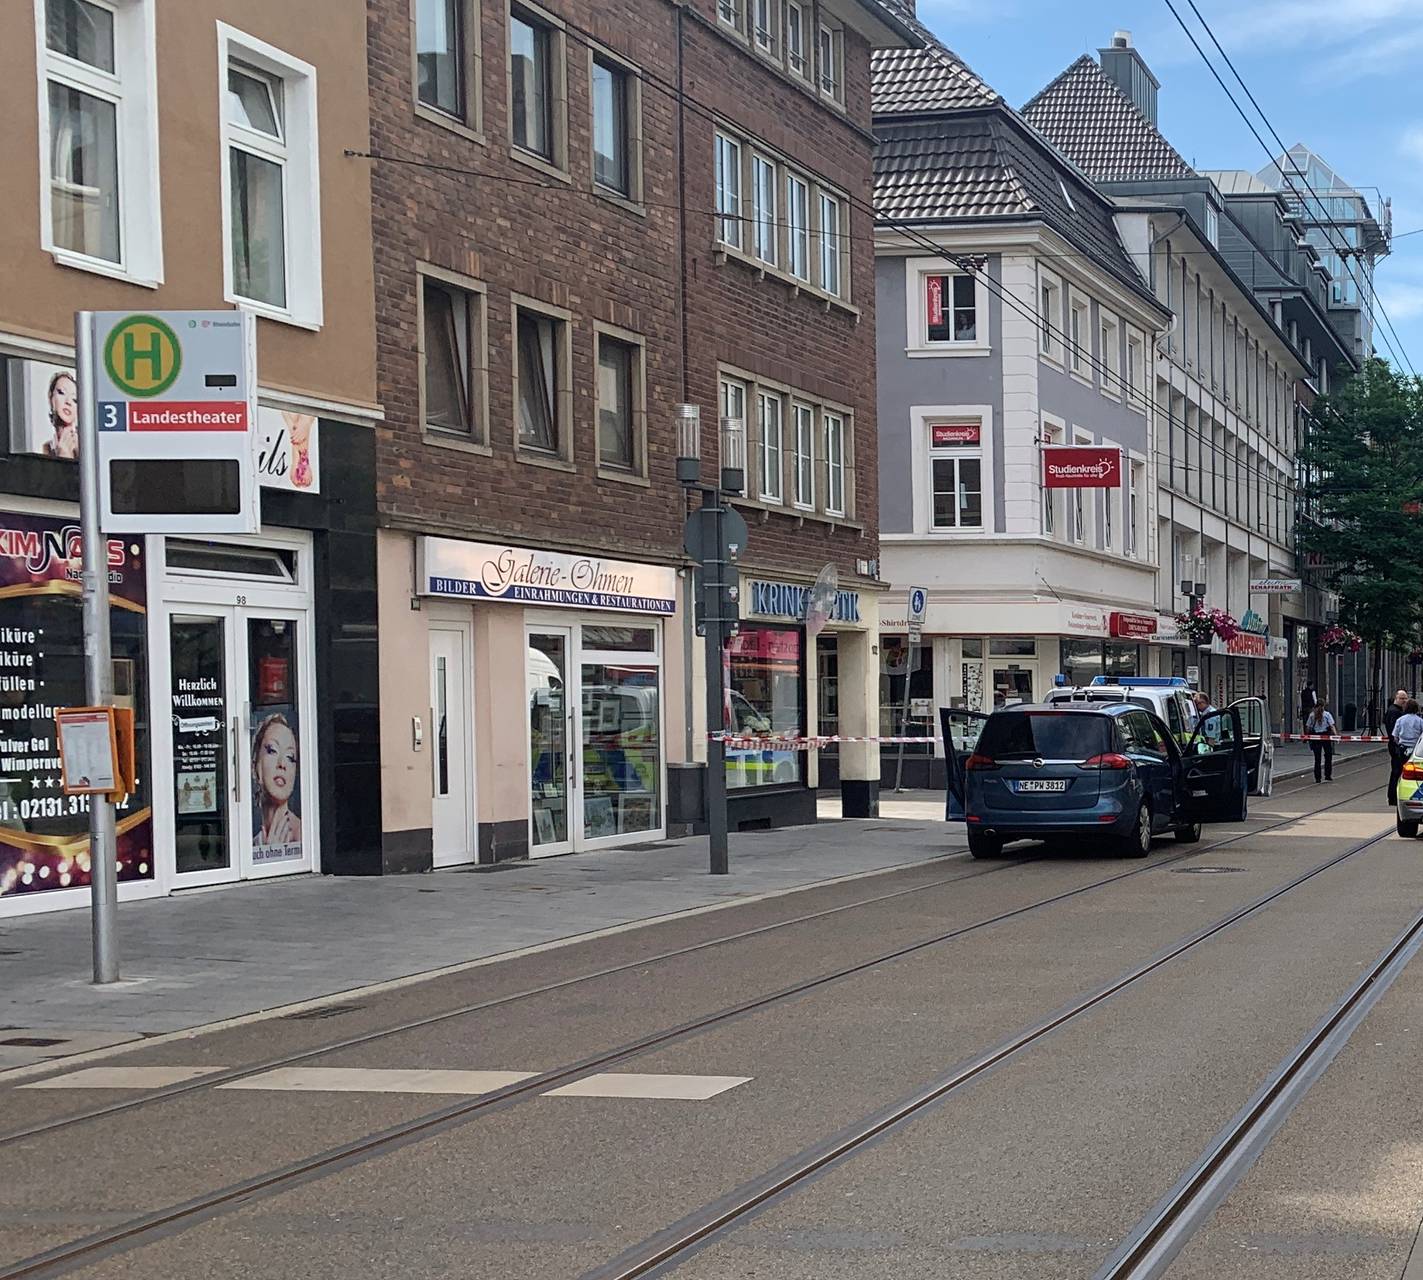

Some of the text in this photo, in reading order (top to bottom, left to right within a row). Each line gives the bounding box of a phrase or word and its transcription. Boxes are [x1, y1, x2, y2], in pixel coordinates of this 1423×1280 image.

[123, 332, 162, 381] H
[104, 404, 242, 428] 3 Landestheater
[1048, 464, 1104, 474] Studienkreis
[236, 596, 246, 605] 98
[436, 578, 671, 612] BILDER EINRAHMUNGEN & RESTAURATIONEN
[31, 737, 49, 752] Gel
[1019, 781, 1029, 790] NE
[1045, 780, 1065, 790] 3812
[266, 847, 282, 858] ohne
